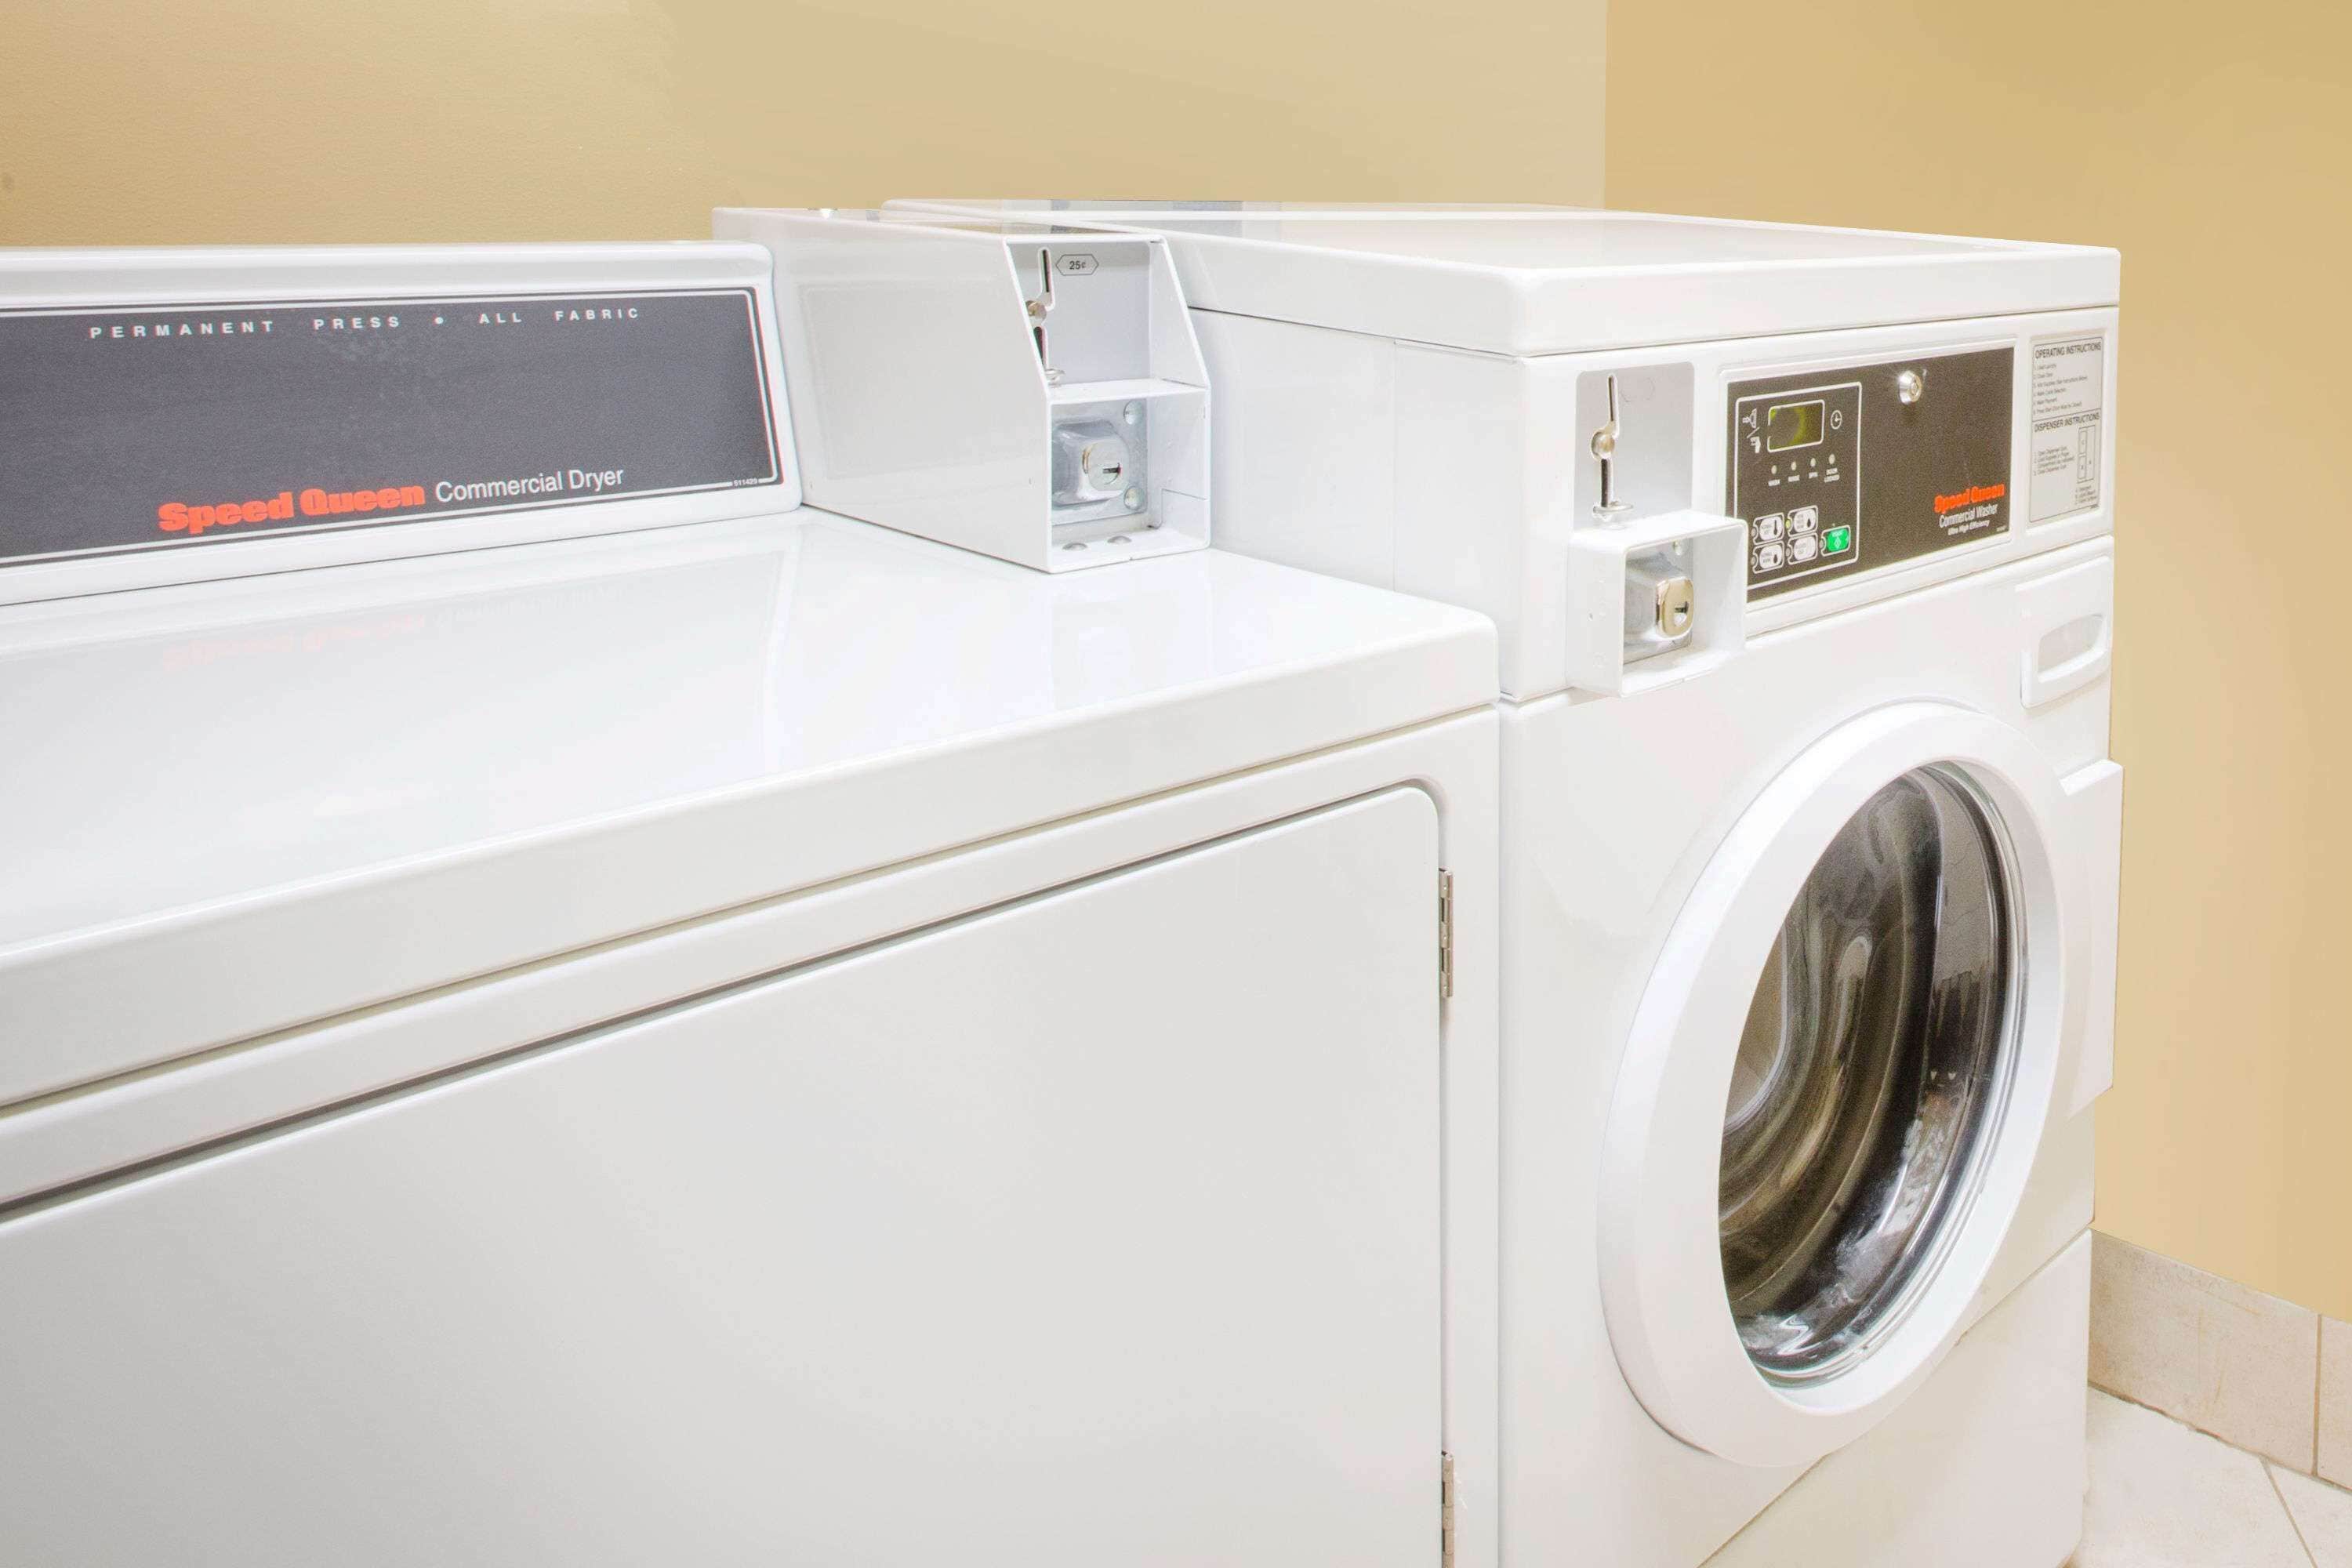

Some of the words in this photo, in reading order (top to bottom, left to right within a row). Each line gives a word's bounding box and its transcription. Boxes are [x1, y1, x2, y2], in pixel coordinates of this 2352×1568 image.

[1069, 260, 1087, 270] 25¢
[89, 320, 274, 339] PERMANENT
[314, 315, 400, 331] PRESS
[478, 312, 522, 325] ALL
[554, 307, 639, 322] FABRIC
[2034, 347, 2065, 359] OPERATING
[2066, 341, 2102, 354] INSTRUCTIONS
[2034, 419, 2064, 433] DISPENSER
[2064, 412, 2100, 426] INSTRUCTIONS
[158, 491, 295, 535] Speed
[299, 485, 426, 517] Queen
[434, 470, 564, 503] Commercial
[568, 468, 625, 492] Dryer
[1933, 488, 1970, 514] Speed
[1970, 484, 2005, 503] Queen
[1939, 506, 1976, 528] Commercial
[1976, 503, 1998, 518] Washer
